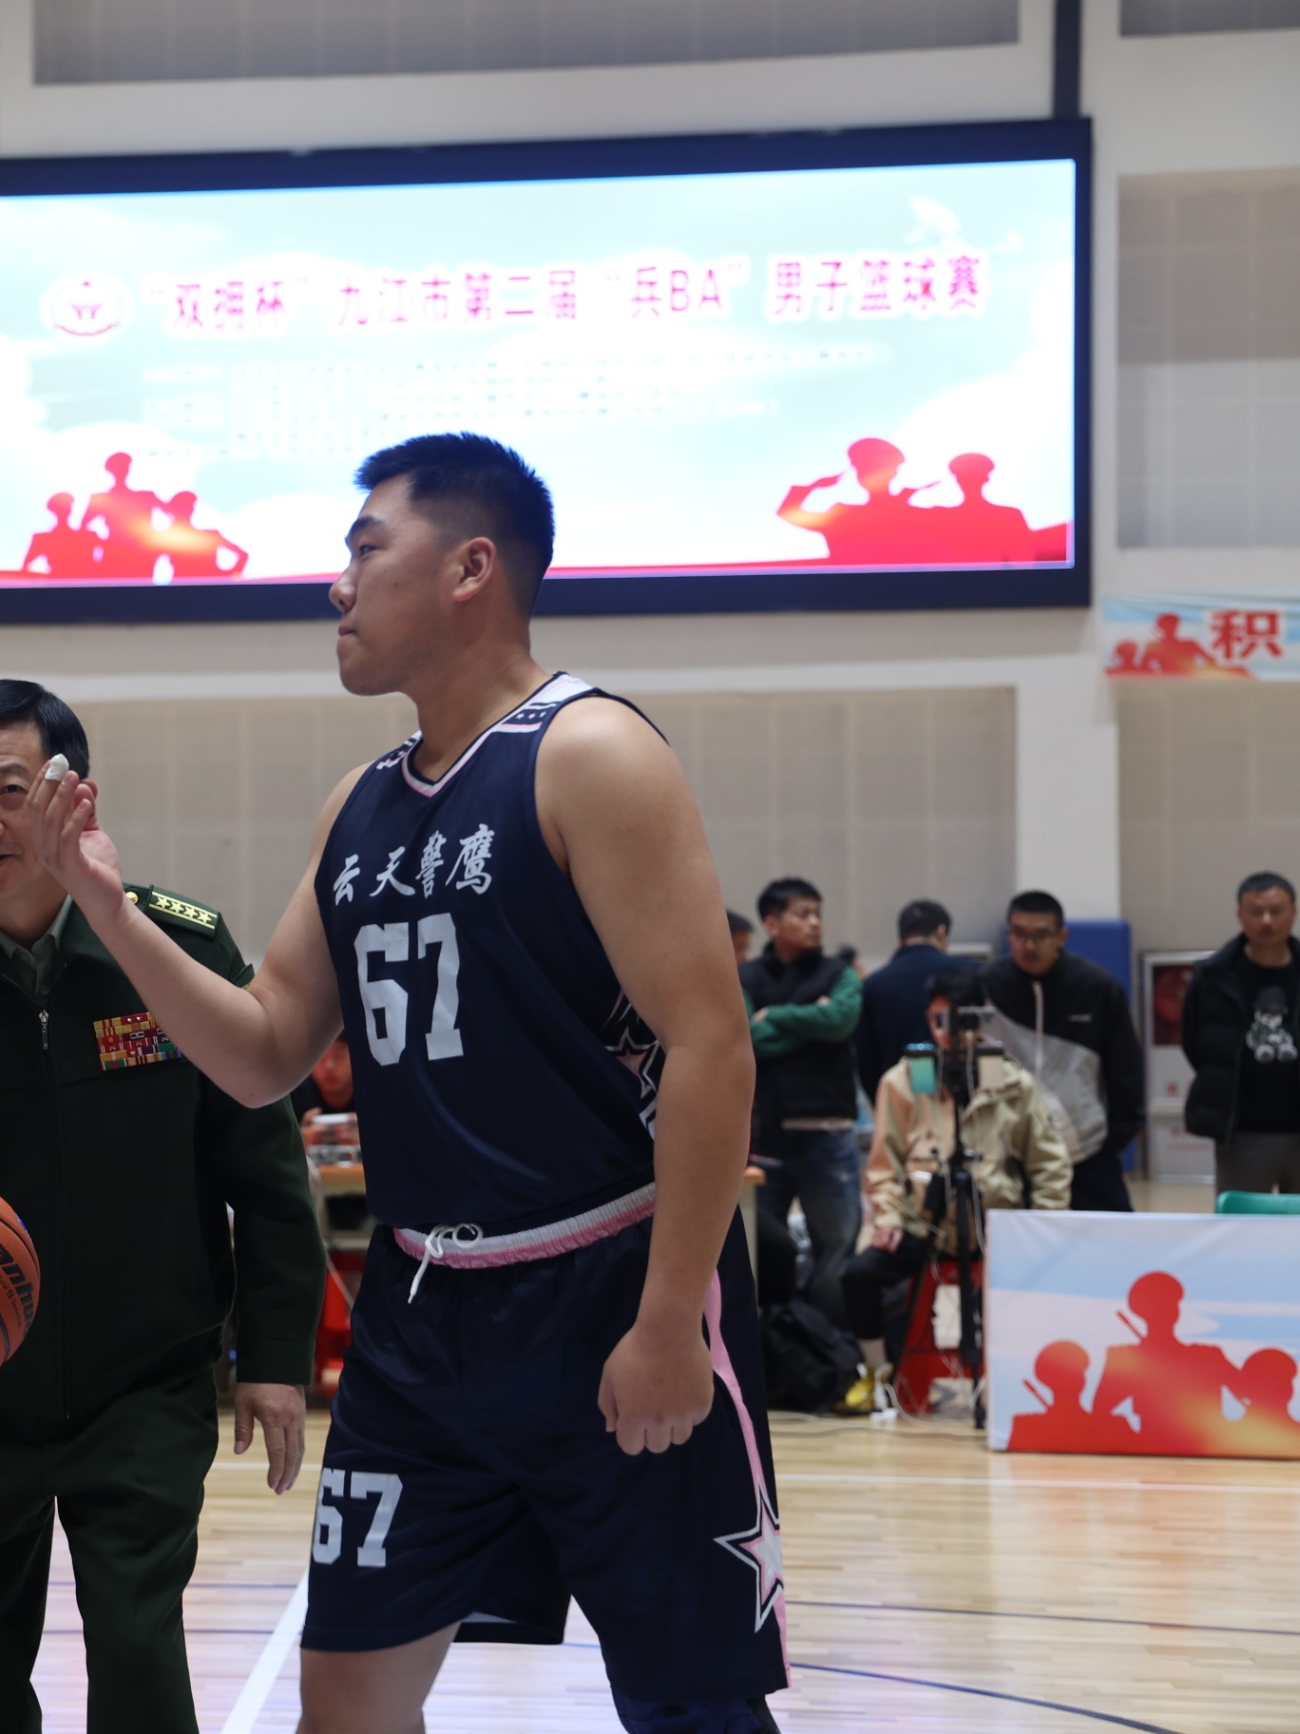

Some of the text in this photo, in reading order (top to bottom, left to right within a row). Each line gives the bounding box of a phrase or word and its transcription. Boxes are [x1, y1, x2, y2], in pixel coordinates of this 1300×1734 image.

[1210, 608, 1283, 660] 积
[332, 822, 496, 906] 云天警鹰
[353, 912, 465, 1067] 67
[311, 1466, 404, 1569] 67
